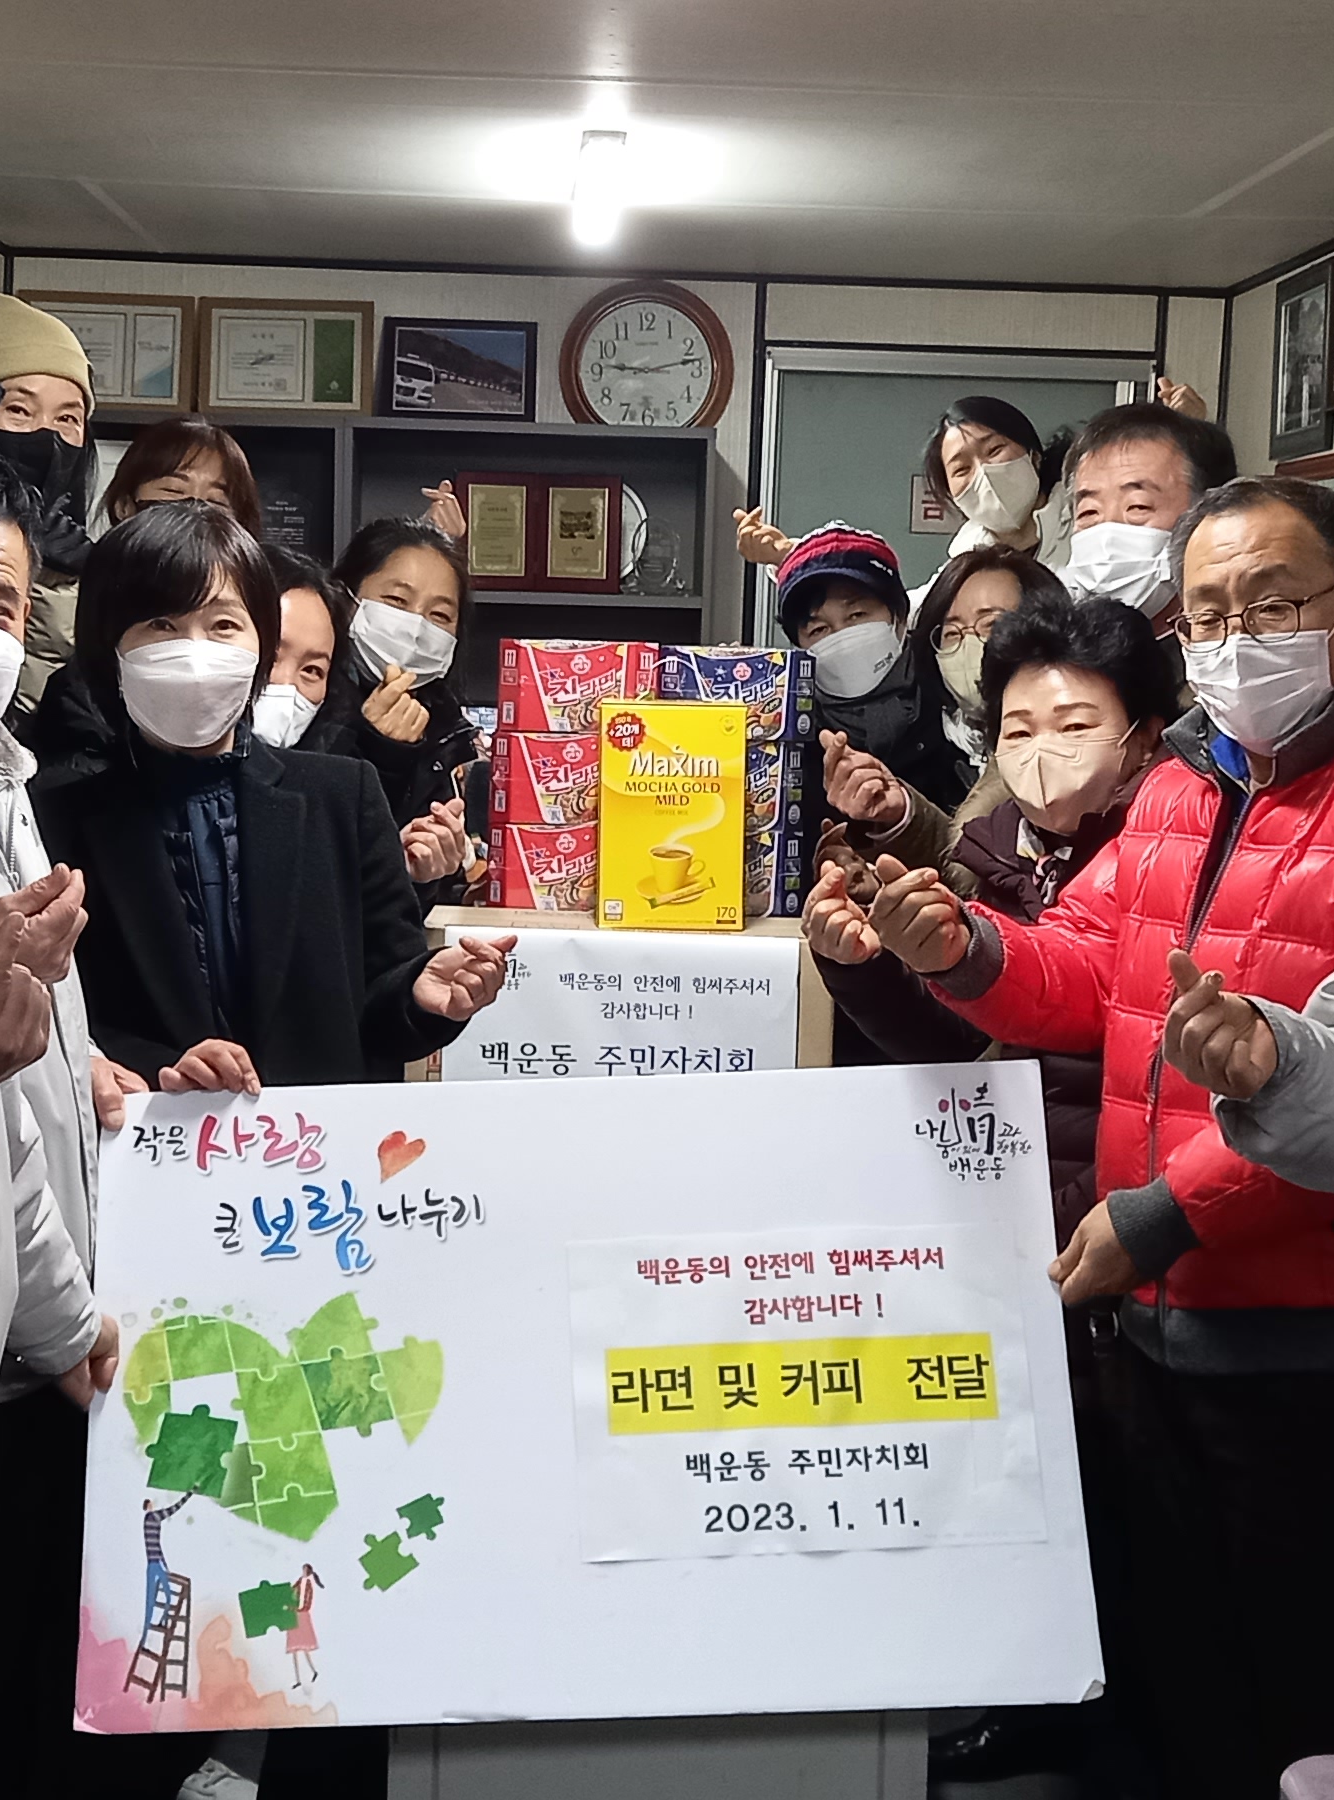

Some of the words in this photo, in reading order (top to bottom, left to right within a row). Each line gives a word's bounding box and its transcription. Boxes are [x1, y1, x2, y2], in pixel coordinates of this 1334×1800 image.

[615, 321, 629, 341] 11
[639, 312, 656, 331] 12
[667, 320, 672, 339] 1
[599, 340, 616, 360] 10
[683, 337, 694, 356] 2
[591, 362, 603, 382] 9
[690, 357, 703, 378] 3
[600, 387, 612, 406] 8
[680, 384, 692, 403] 4
[619, 403, 631, 422] 7
[641, 408, 655, 426] 6
[665, 401, 677, 420] 5
[547, 668, 616, 705] 진라면
[629, 748, 720, 778] Maxim
[624, 781, 678, 793] MOCHA
[681, 782, 720, 794] GOLD
[654, 794, 690, 806] MILD
[716, 907, 737, 919] 170
[559, 972, 623, 992] 백운동의
[633, 974, 681, 993] 안전에
[600, 1002, 681, 1021] 감사합니다
[479, 1041, 578, 1076] 백운동
[594, 1045, 755, 1076] 주민자치회
[132, 1124, 187, 1163] 작은
[195, 1112, 324, 1171] 사랑
[948, 1157, 1006, 1181] 백운동
[213, 1202, 241, 1249] 큰
[252, 1179, 372, 1271] 보람
[637, 1256, 732, 1285] 백운동의
[744, 1251, 815, 1282] 안전에
[827, 1246, 945, 1276] 힘써주셔서
[743, 1293, 863, 1325] 감사합니다
[875, 1293, 884, 1318] !
[610, 1364, 696, 1414] 라면
[717, 1361, 759, 1409] 및
[780, 1357, 864, 1406] 커피
[906, 1352, 990, 1402] 전달
[685, 1450, 772, 1483] 백운동
[788, 1442, 930, 1478] 주민자치회
[704, 1502, 808, 1535] 2023.
[827, 1500, 855, 1530] 1.
[874, 1497, 921, 1528] 11.
